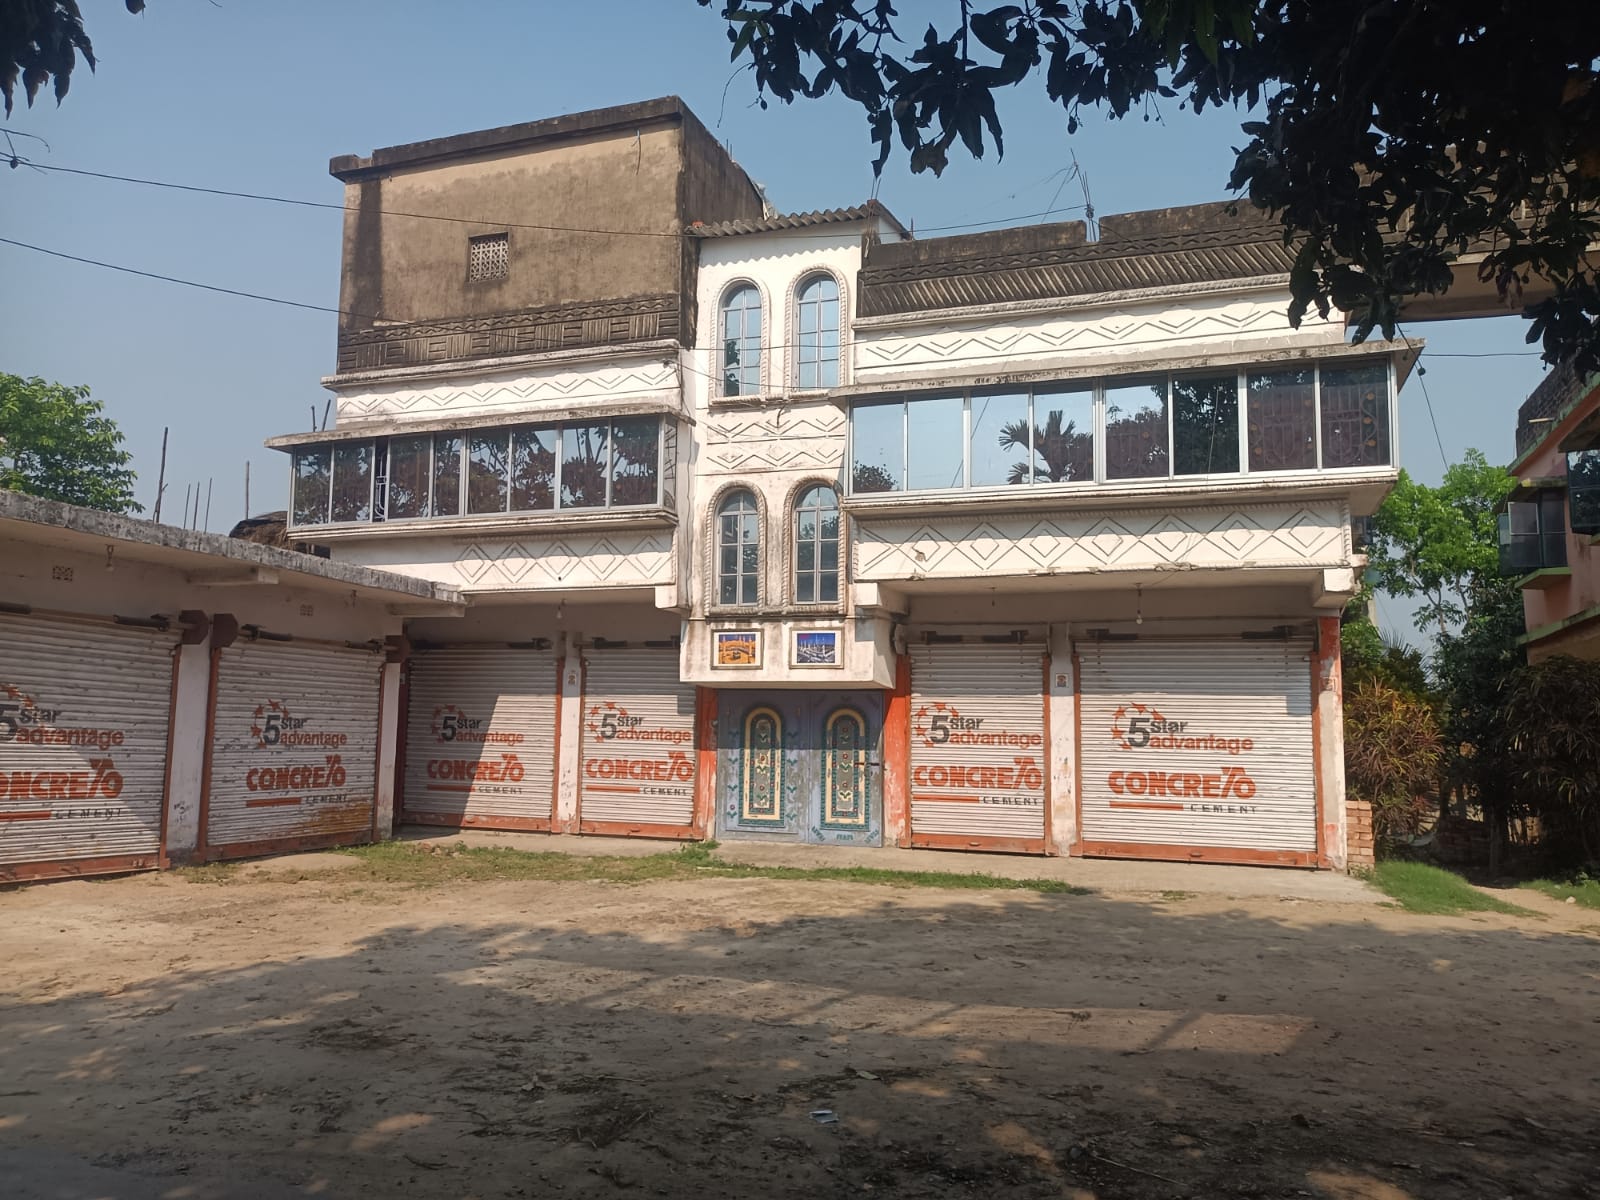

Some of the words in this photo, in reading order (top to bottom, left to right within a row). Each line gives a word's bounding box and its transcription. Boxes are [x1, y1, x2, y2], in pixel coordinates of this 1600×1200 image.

[0, 704, 19, 740] 5
[263, 715, 281, 745] 5
[441, 716, 456, 741] 5
[600, 713, 617, 740] 5
[930, 715, 950, 744] 5
[1127, 717, 1150, 747] 5
[16, 725, 125, 750] advantage
[280, 731, 347, 749] advantage
[456, 730, 524, 747] advantage
[616, 726, 692, 745] advantage
[949, 729, 1041, 750] advantage
[1150, 733, 1254, 756] advantage
[305, 794, 348, 804] CEMENT
[478, 786, 524, 795] CEMENT
[643, 787, 689, 796] CEMENT
[983, 796, 1040, 805] CEMENT
[55, 807, 122, 820] CEMENT
[1190, 804, 1257, 814] CEMENT
